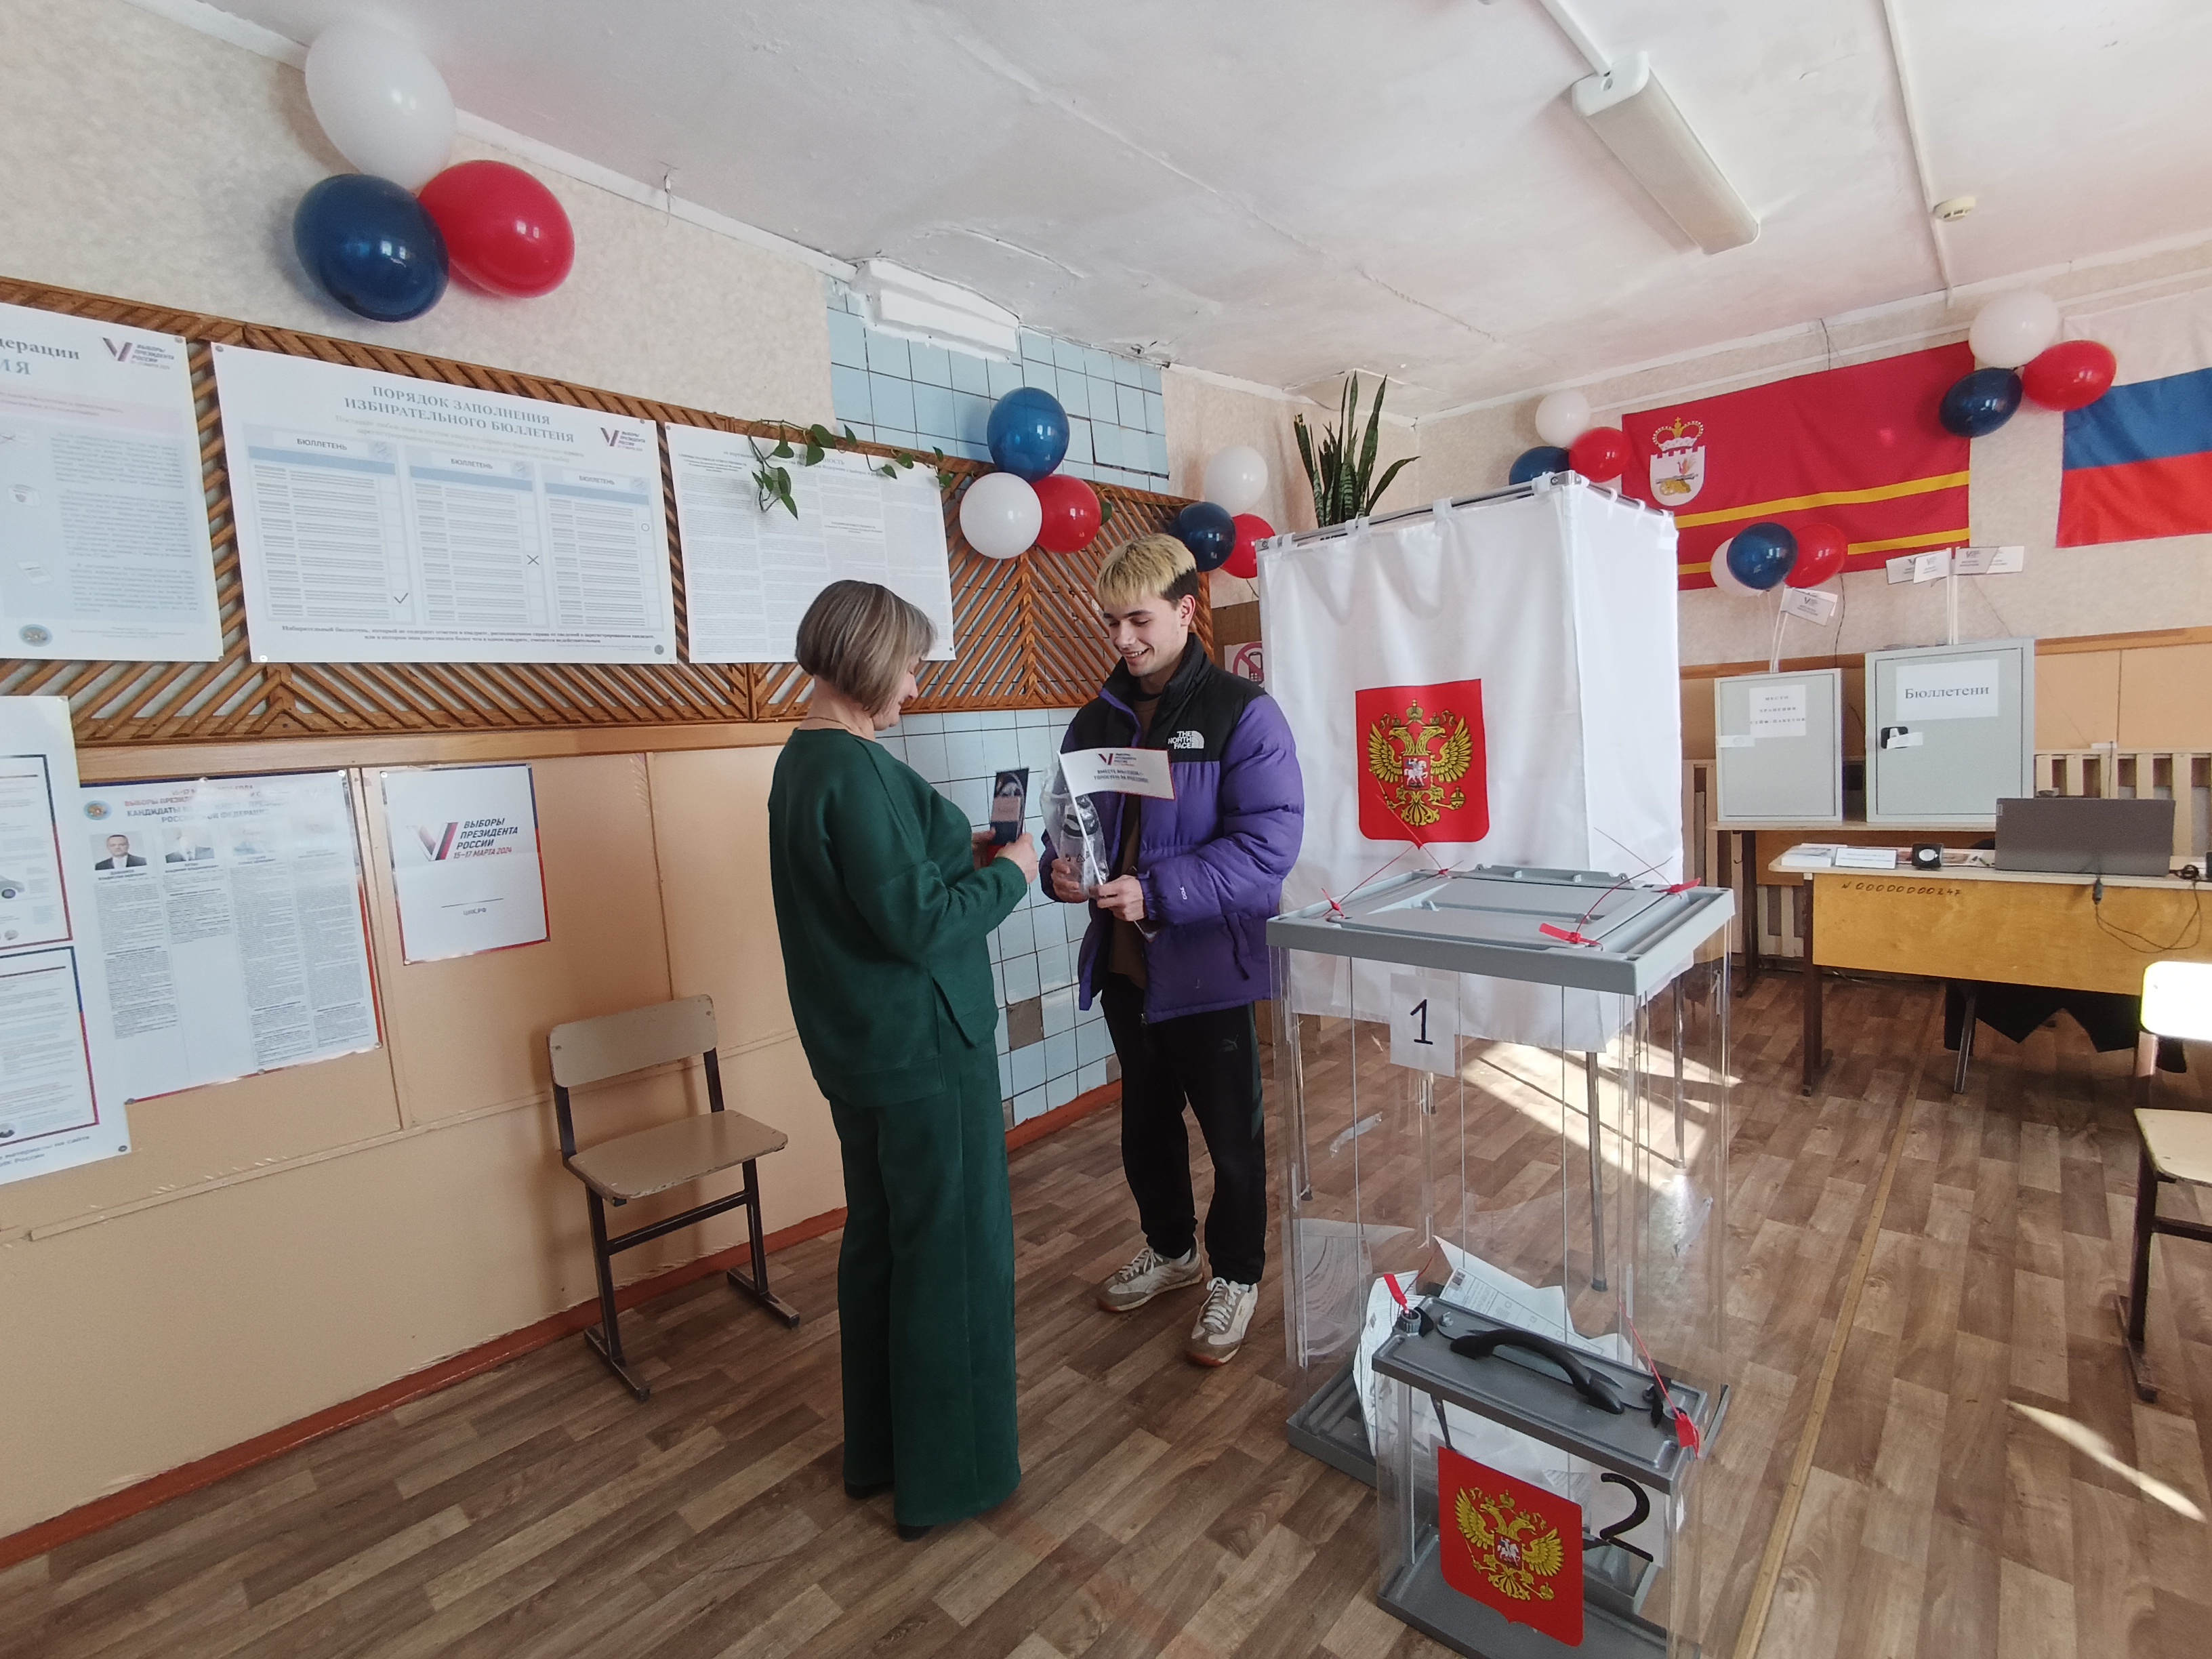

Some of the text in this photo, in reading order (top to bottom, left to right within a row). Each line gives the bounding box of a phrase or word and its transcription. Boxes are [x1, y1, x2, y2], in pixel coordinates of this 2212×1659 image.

[372, 386, 550, 425] ПОРЯДОК ЗАПОЛНЕНИЯ
[344, 397, 487, 429] ИЗБИРАТЕЛЬНОГО
[491, 421, 574, 443] БЮЛЛЕТЕНЯ
[297, 438, 348, 451] БЮЛЛЕТЕНЬ
[451, 458, 493, 470] БЮЛЛЕТЕНЬ
[579, 475, 615, 485] БЮЛЛЕТЕНЬ
[1905, 687, 1989, 699] Бюллетени
[1167, 736, 1192, 745] NORTH
[127, 806, 181, 817] КАНДИДАТЫ
[464, 817, 506, 829] ВЫБОРЫ
[459, 826, 518, 840] ПРЕЗИДЕНТА
[456, 838, 495, 850] РОССИИ
[472, 848, 496, 857] МАРТА
[496, 846, 512, 855] 2024
[1179, 886, 1187, 900] 700
[1410, 999, 1433, 1045] 1
[1599, 1473, 1654, 1563] 2
